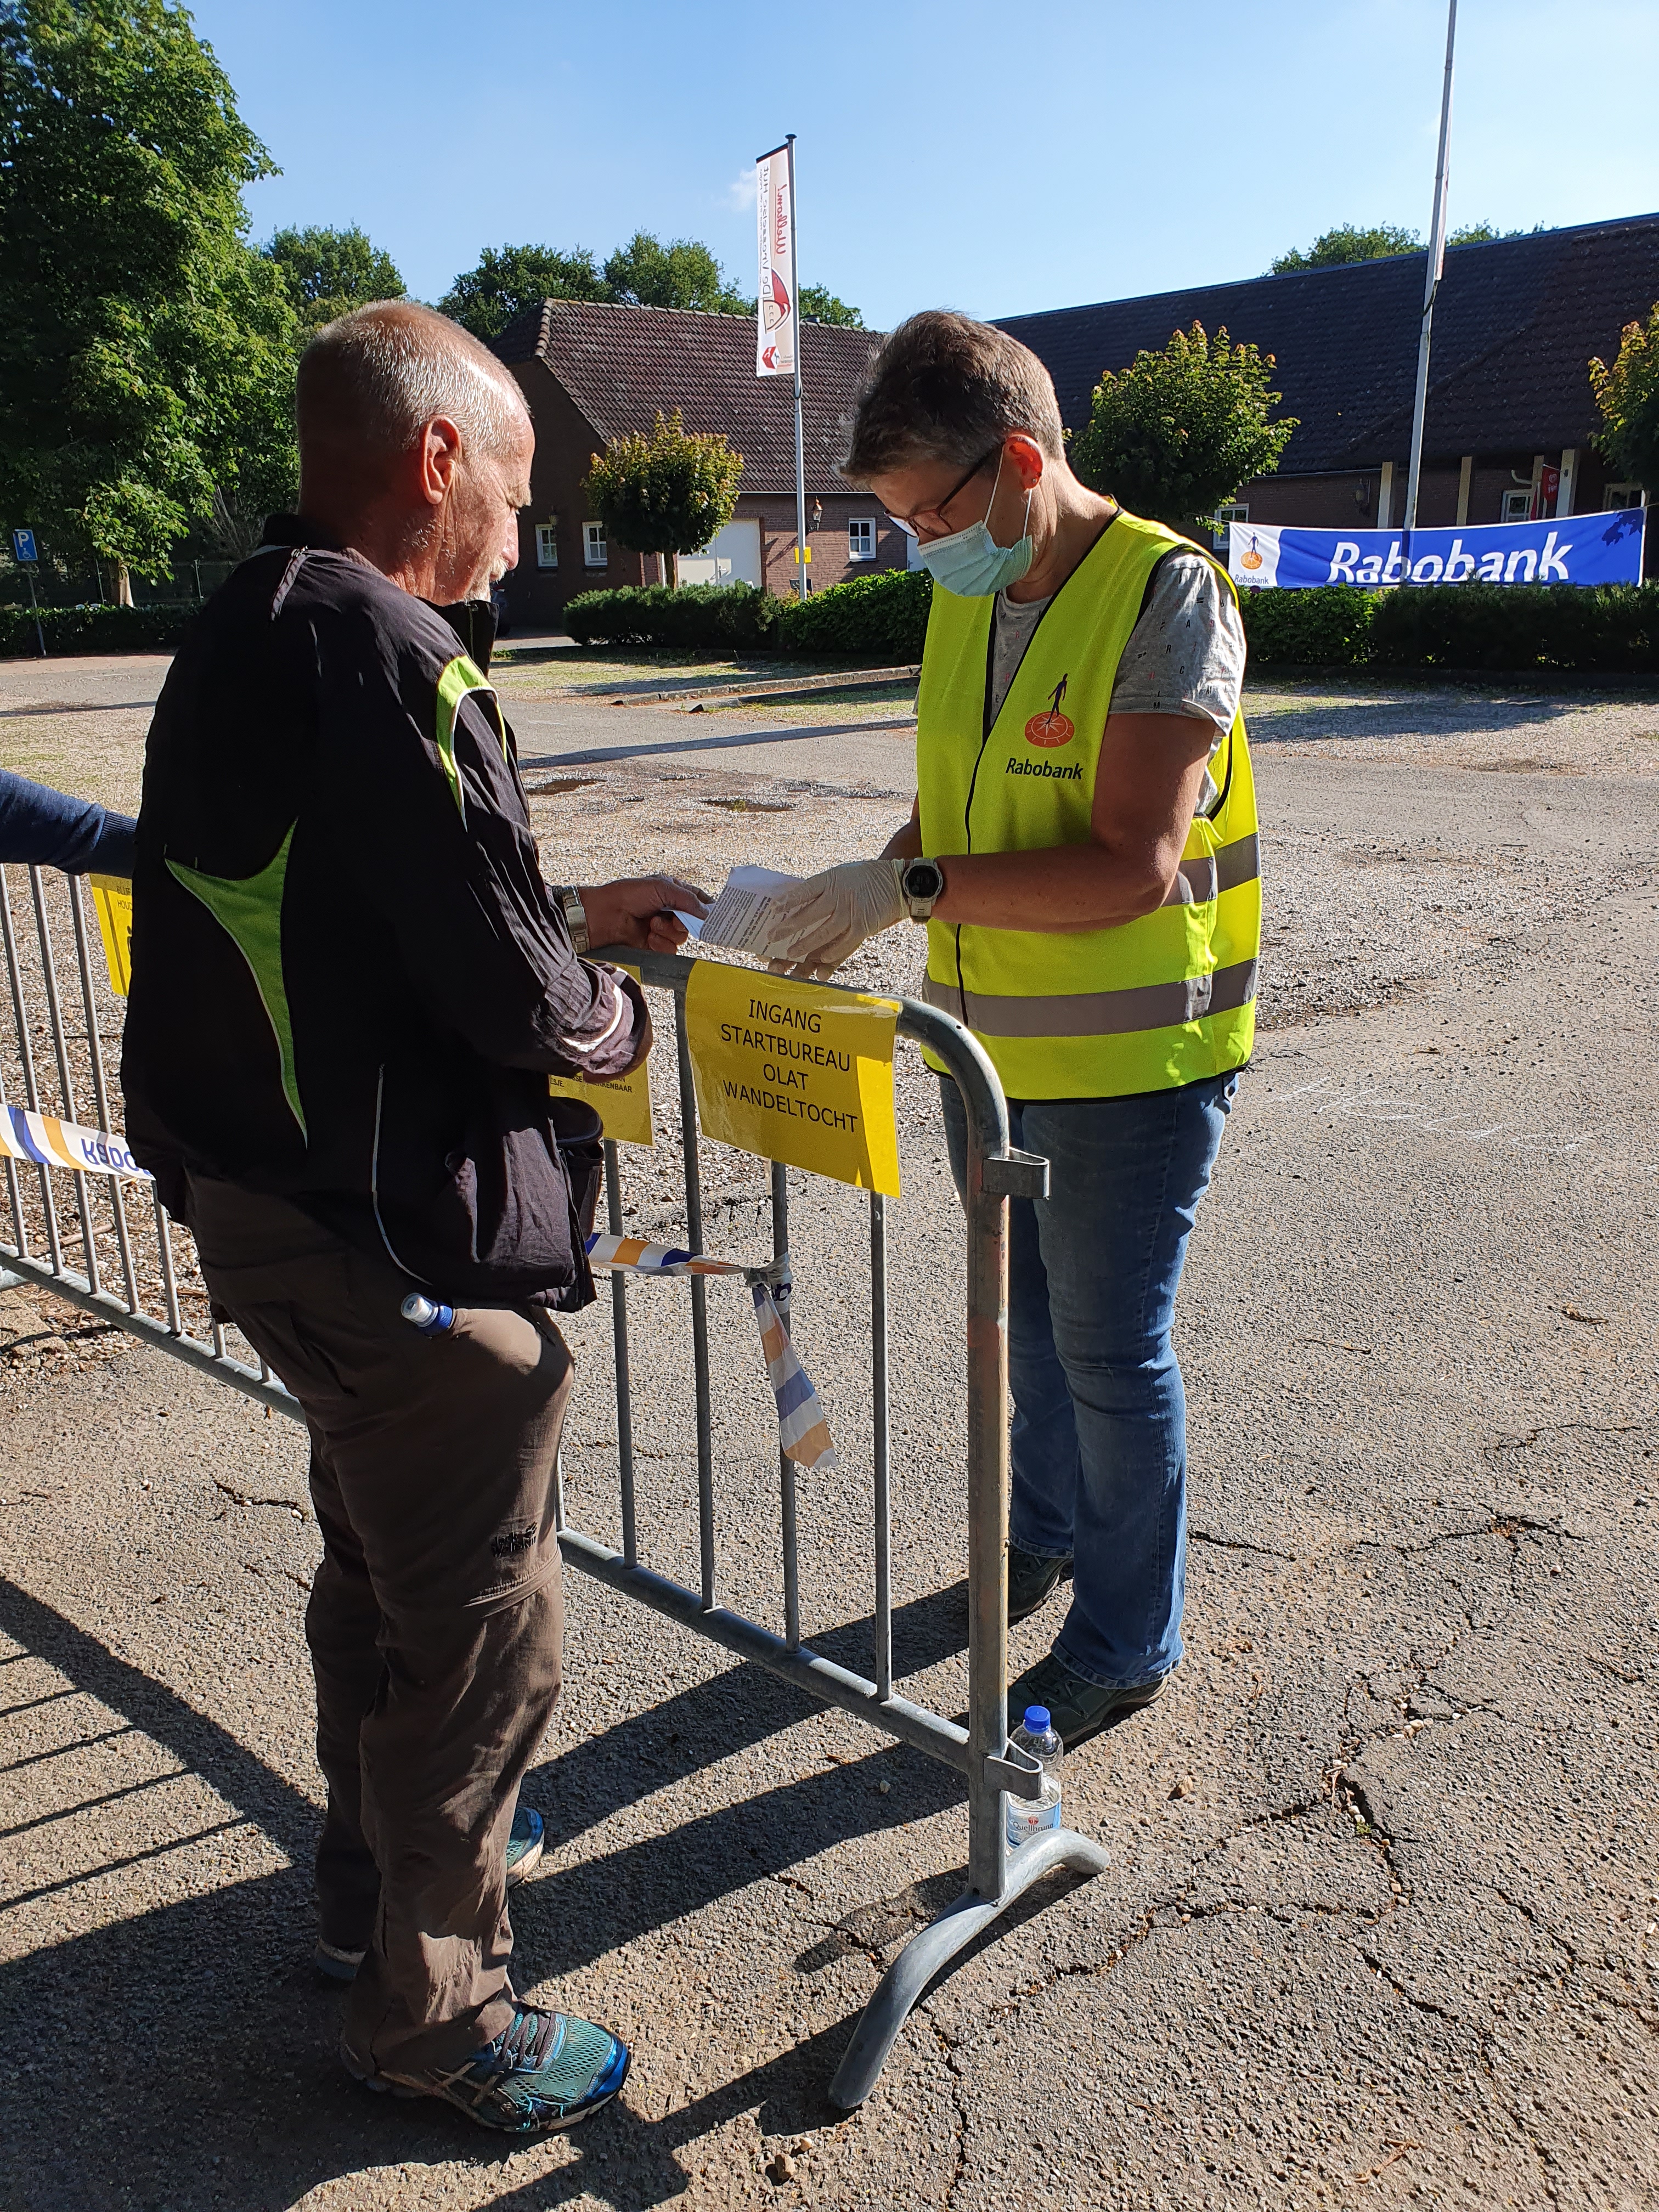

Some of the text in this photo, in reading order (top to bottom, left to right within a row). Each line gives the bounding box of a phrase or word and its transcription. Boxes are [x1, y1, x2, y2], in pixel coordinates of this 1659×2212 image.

[18, 532, 29, 548] P
[1326, 531, 1573, 583] Rabobank
[1234, 574, 1269, 585] Rabobank
[1005, 758, 1084, 780] Rabobank
[748, 998, 821, 1034] INGANG
[721, 1023, 850, 1072] STARTBUREAU
[763, 1063, 809, 1091] OLAT
[723, 1079, 858, 1133] WANDELTOCHT
